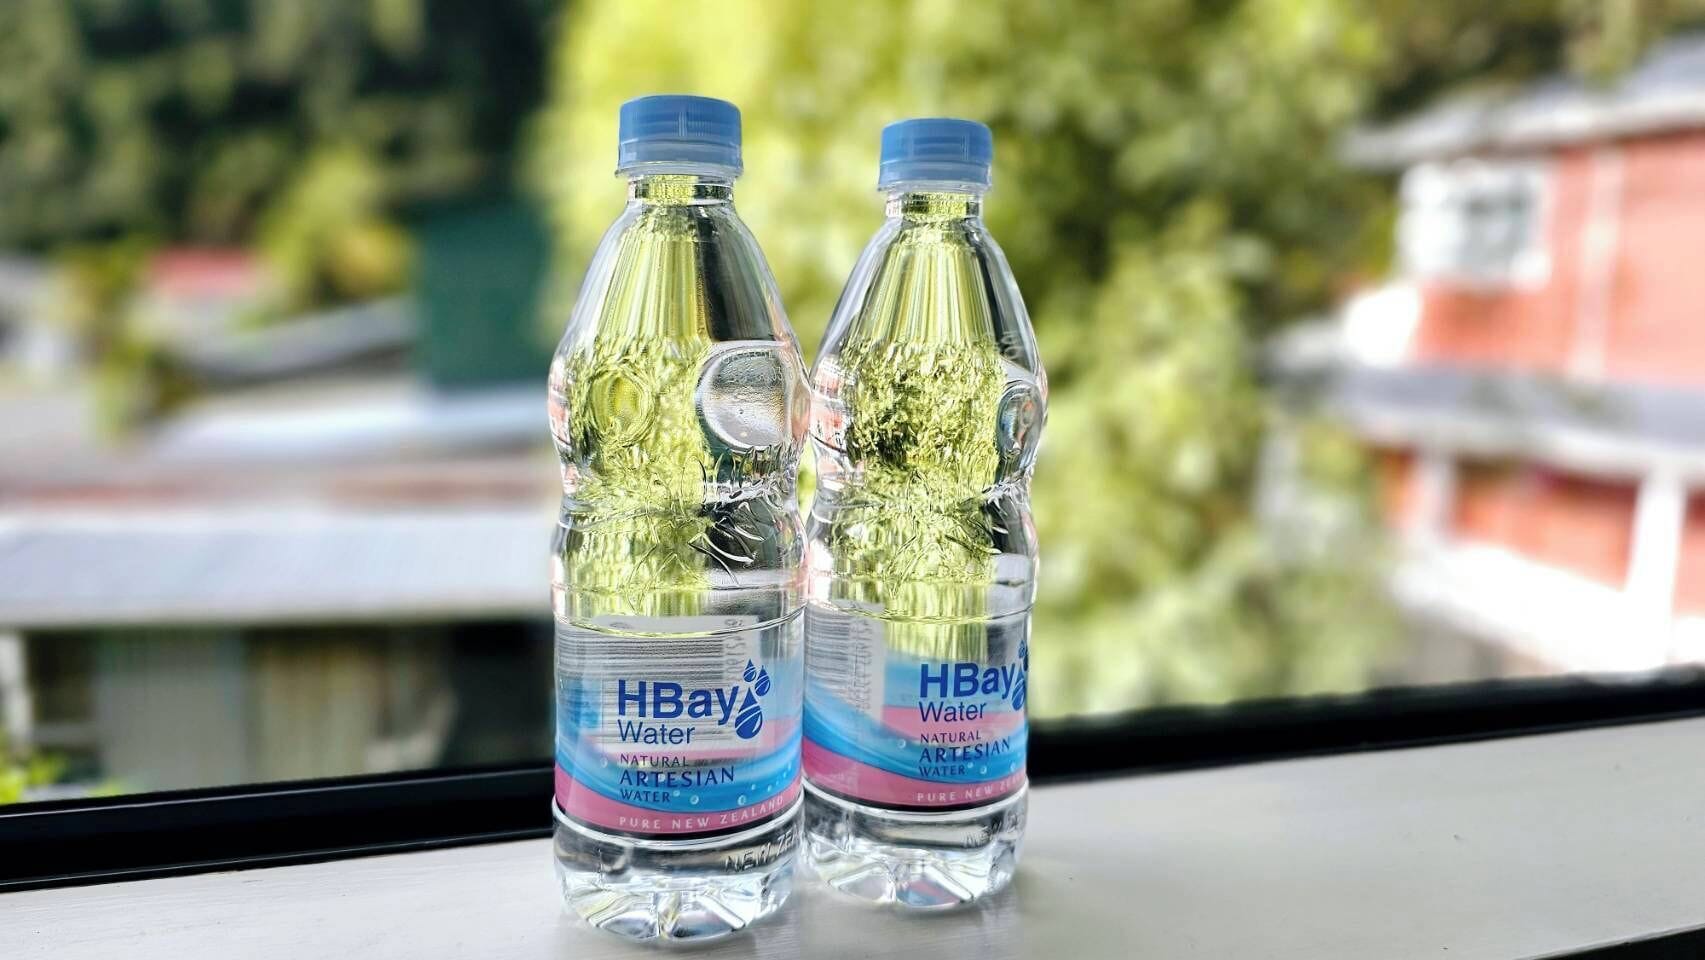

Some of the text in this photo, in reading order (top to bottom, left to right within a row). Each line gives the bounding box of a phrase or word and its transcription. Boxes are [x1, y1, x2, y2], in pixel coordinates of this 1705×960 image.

[920, 663, 1016, 699] HBay
[618, 680, 739, 725] HBay
[919, 701, 986, 722] Water
[618, 720, 695, 745] Water
[920, 731, 982, 743] NATURAL
[920, 737, 1011, 763] ARTESIAN
[620, 753, 689, 768] NATURAL
[620, 767, 734, 787] ARTESIAN
[919, 766, 965, 777] WATER
[620, 788, 670, 802] WATER
[917, 791, 956, 802] PURE
[965, 785, 993, 799] NEW
[618, 797, 784, 829] PURE NEW ZEALAND
